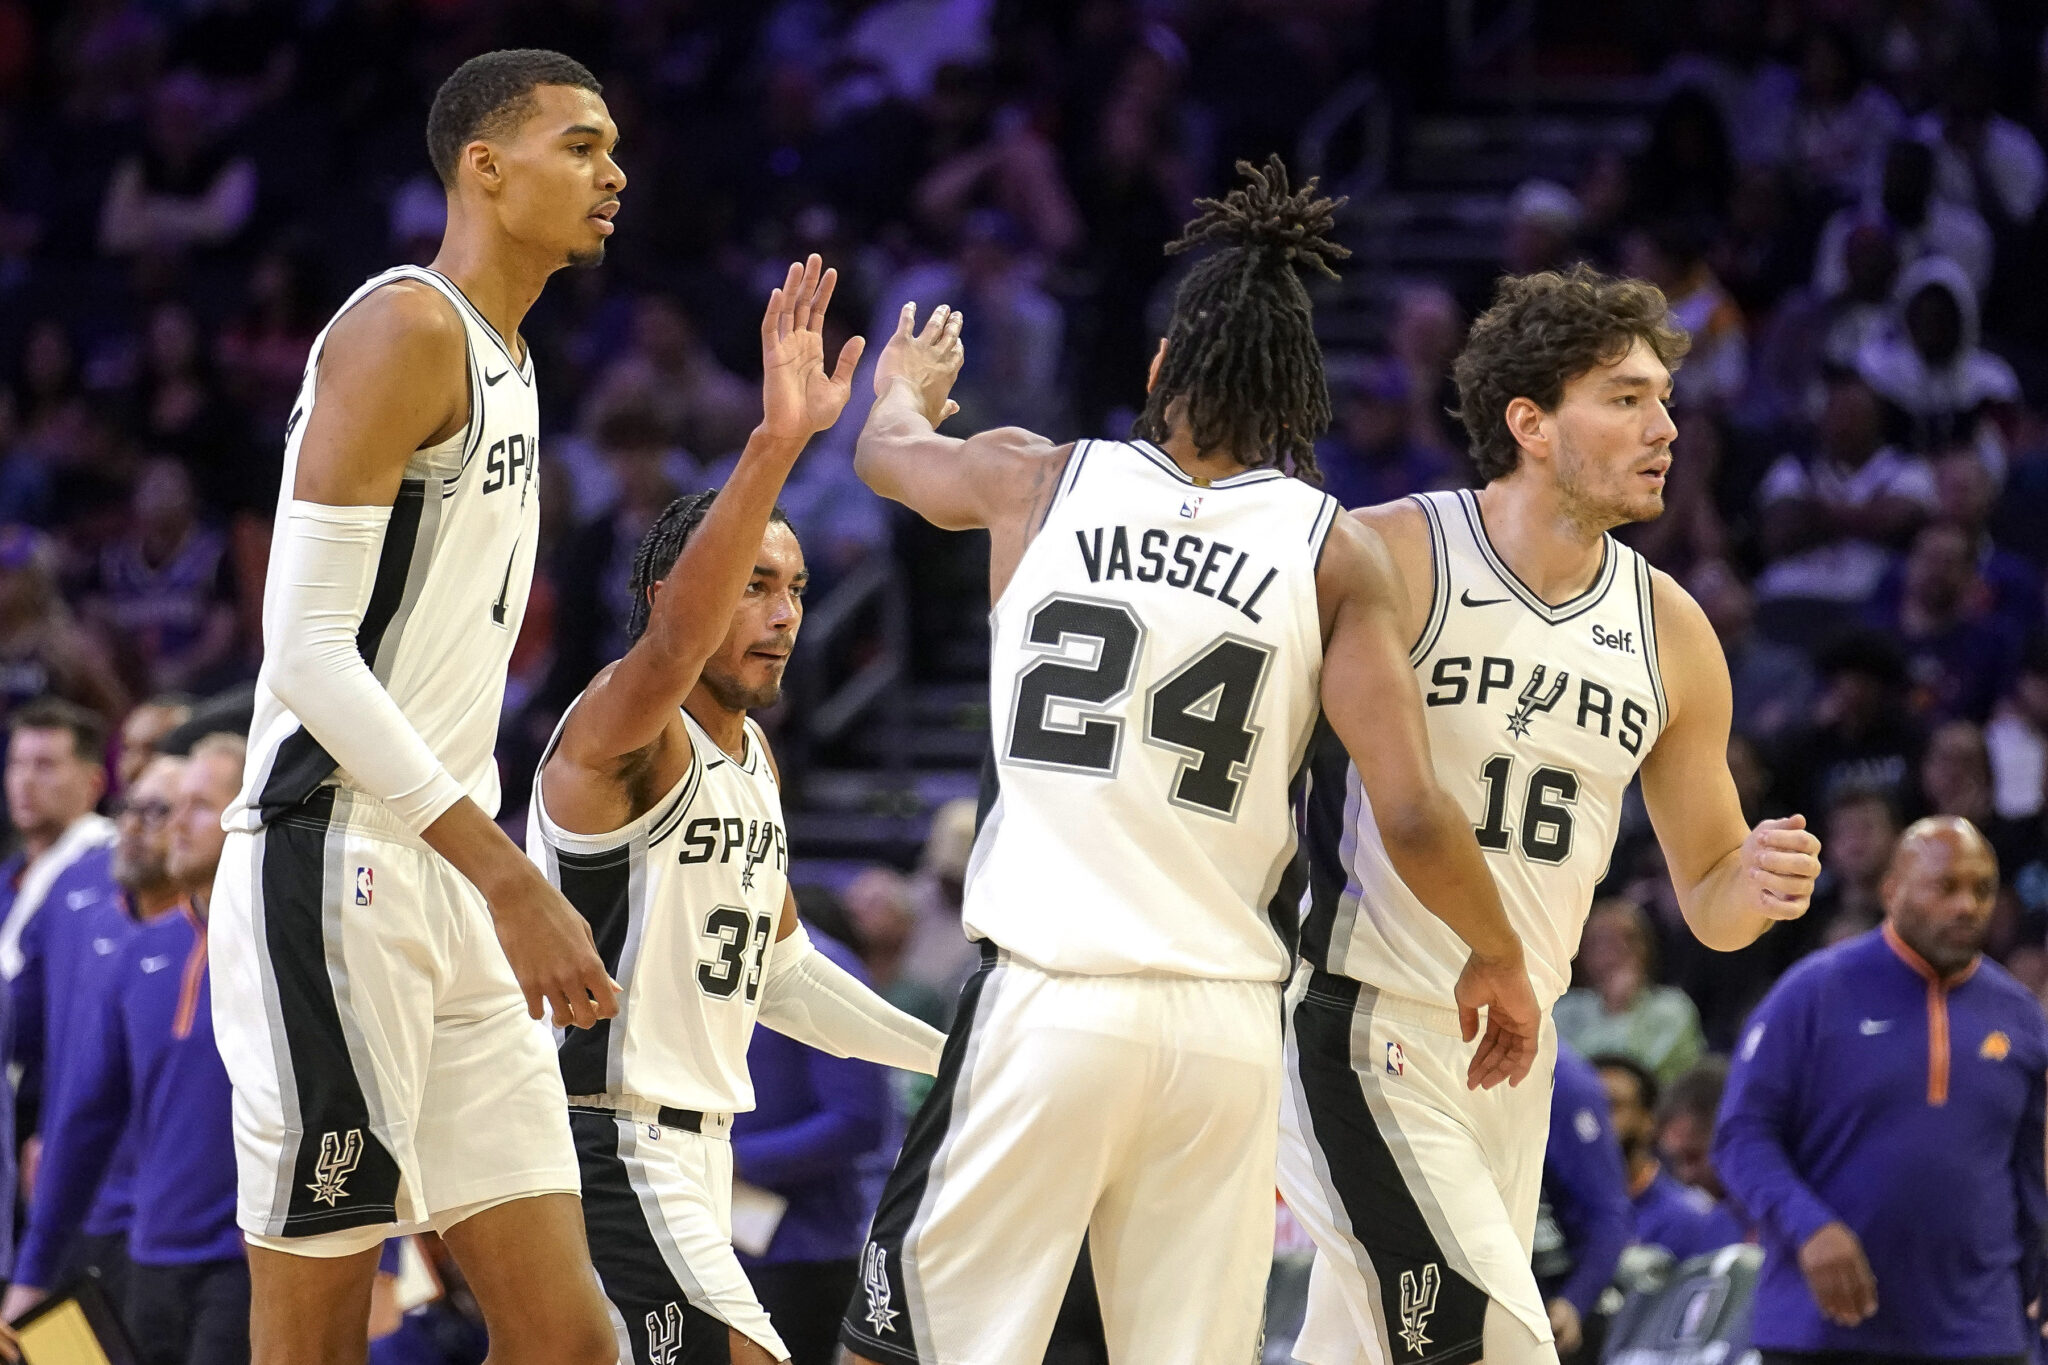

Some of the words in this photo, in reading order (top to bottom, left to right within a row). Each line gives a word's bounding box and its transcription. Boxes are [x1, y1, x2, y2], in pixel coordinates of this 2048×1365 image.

[483, 433, 539, 508] SPU
[1075, 525, 1280, 625] VASSELL
[1592, 624, 1636, 655] Self.
[1000, 591, 1279, 824] 24
[1427, 655, 1648, 758] SPURS
[679, 817, 787, 885] SPUR
[1471, 752, 1582, 867] 16
[695, 903, 774, 1006] 33
